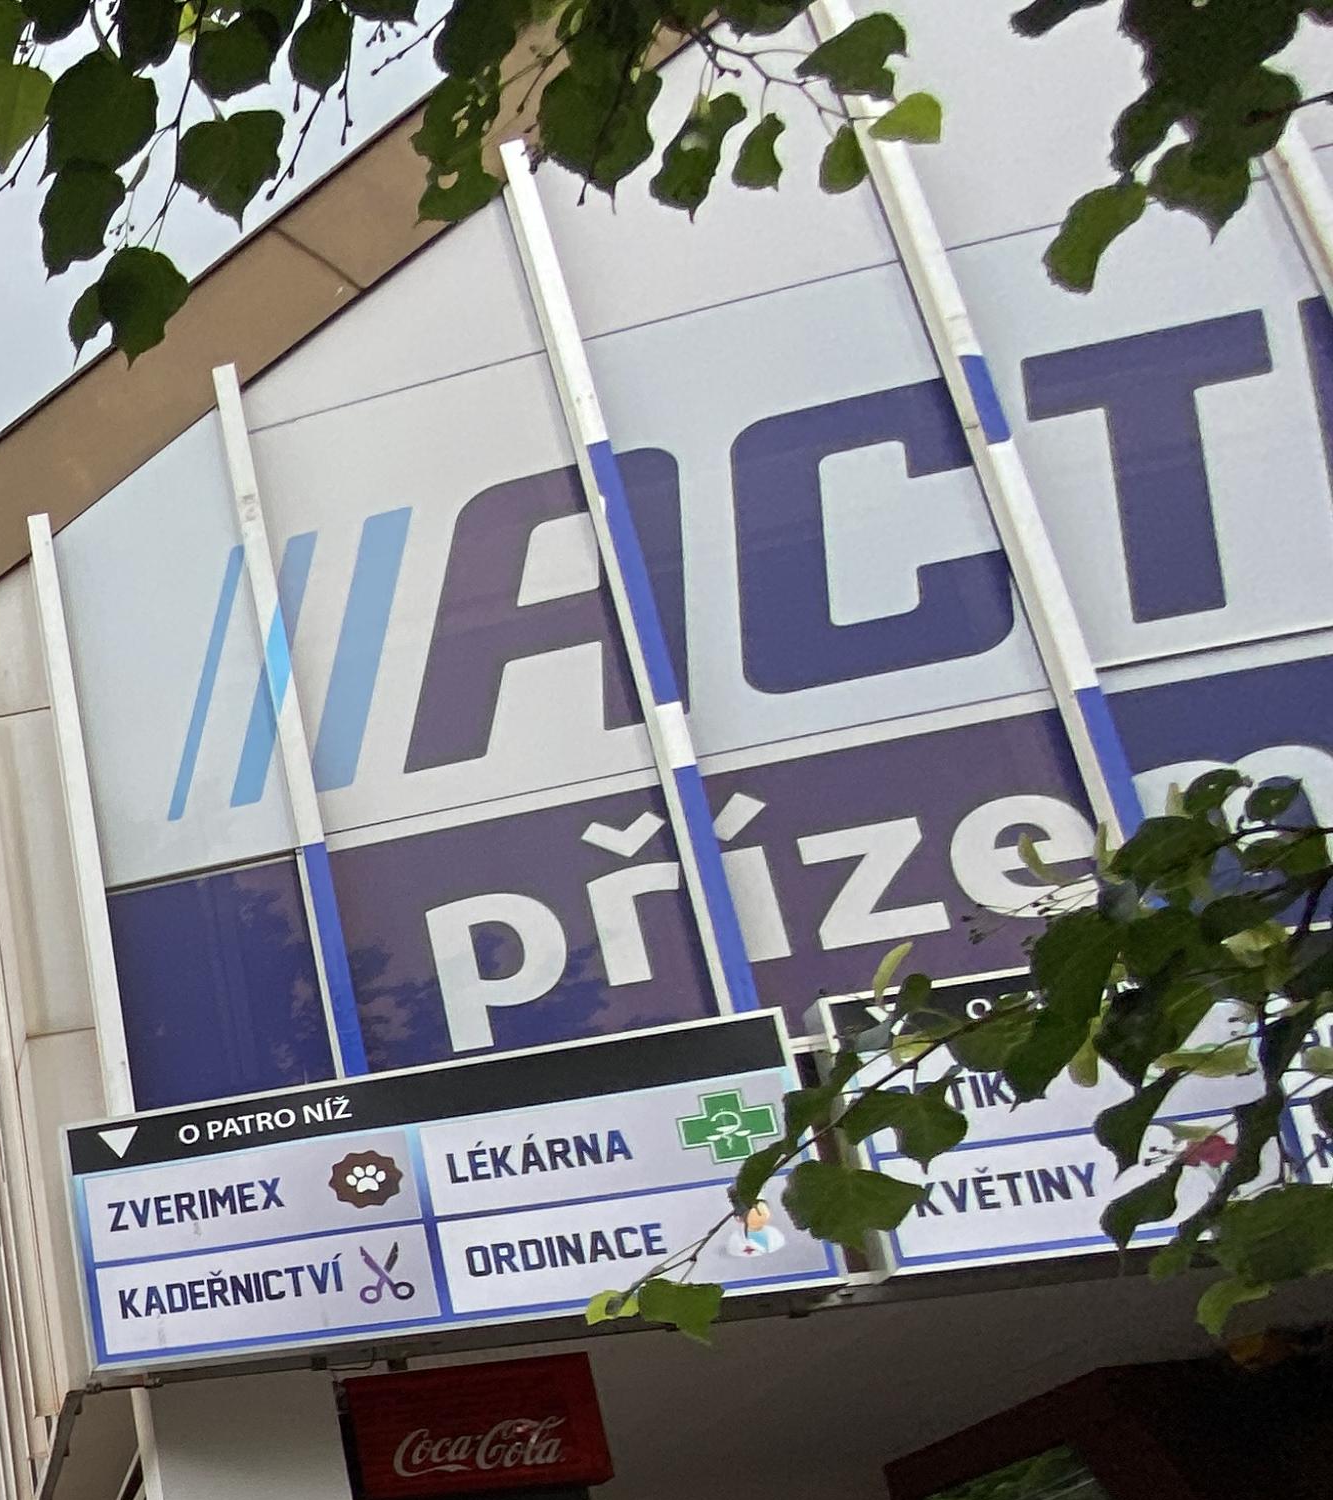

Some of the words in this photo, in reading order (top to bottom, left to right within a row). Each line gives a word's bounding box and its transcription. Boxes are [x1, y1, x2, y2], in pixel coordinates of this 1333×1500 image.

[178, 1124, 200, 1144] O
[207, 1108, 296, 1141] PATRO
[303, 1096, 353, 1124] NÍŽ
[446, 1129, 633, 1184] LÉKÁRNA
[107, 1177, 285, 1232] ZVERIMEX
[915, 1161, 1097, 1218] KVĚTINY
[465, 1222, 667, 1277] ORDINACE
[119, 1253, 344, 1319] KADEŘNICTVÍ
[393, 1415, 567, 1477] Coca-Cola
